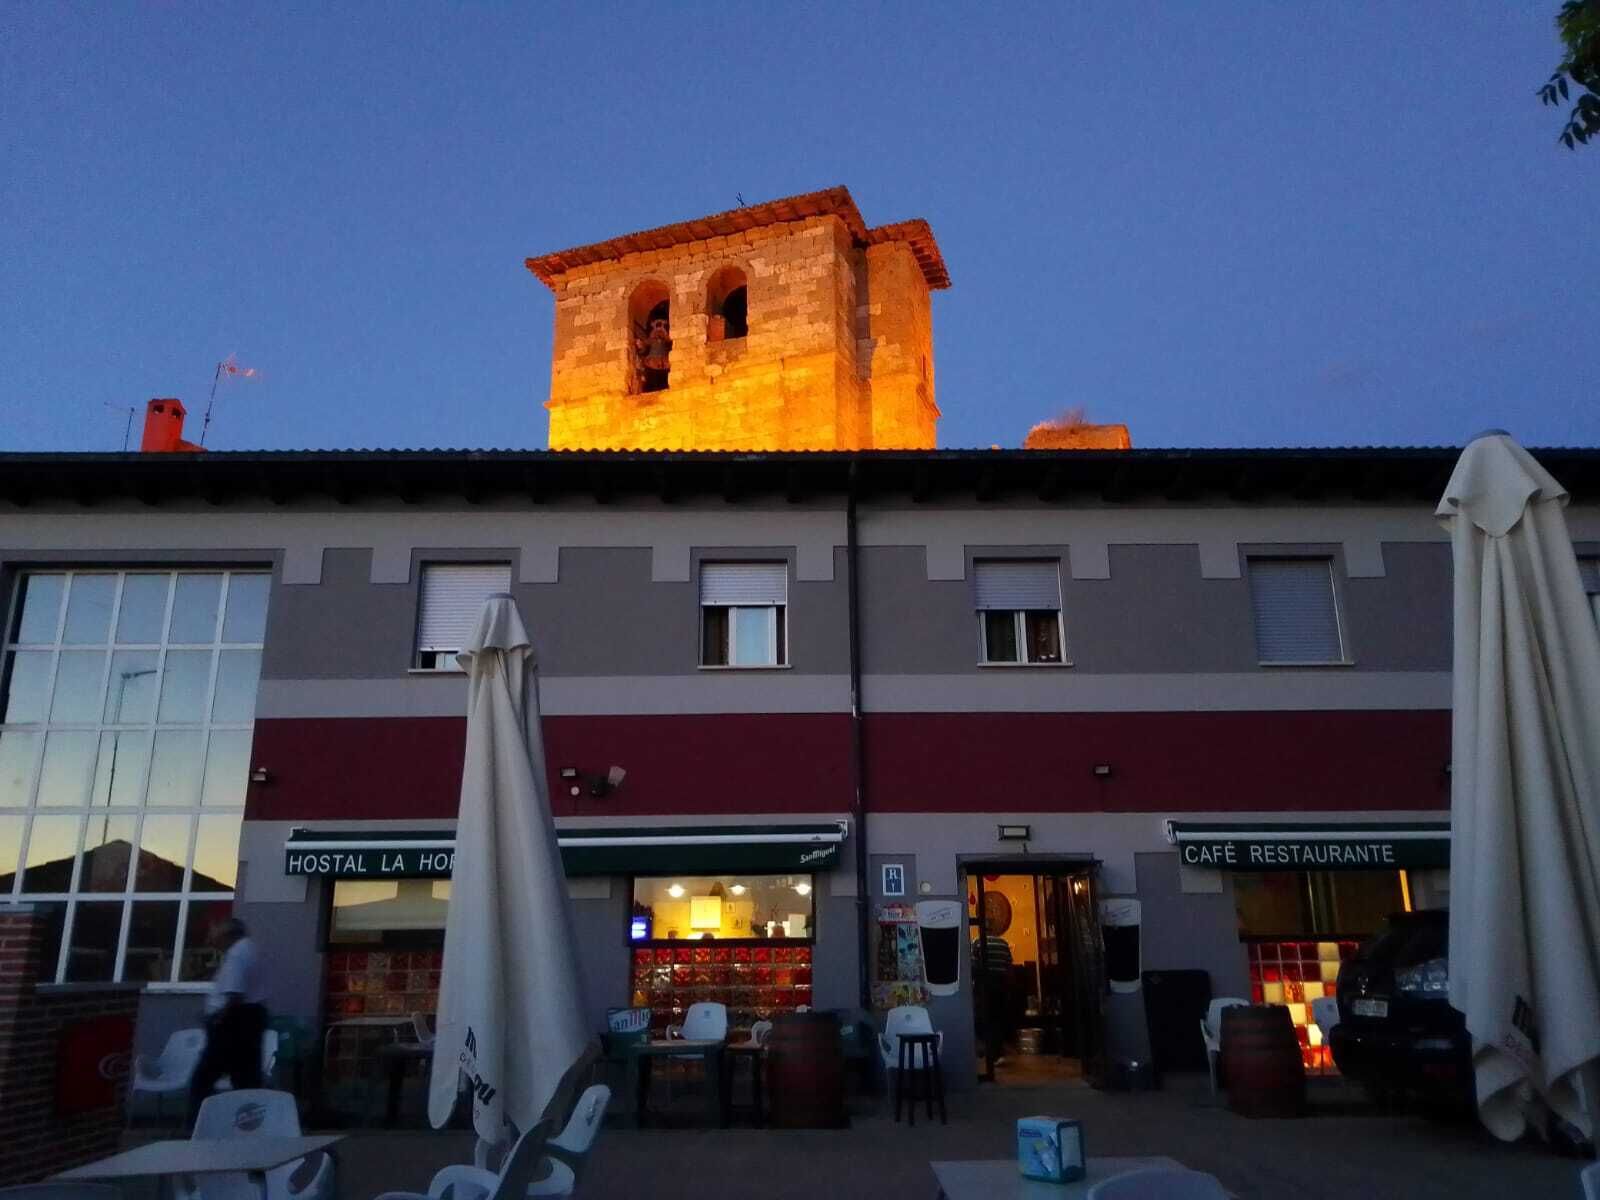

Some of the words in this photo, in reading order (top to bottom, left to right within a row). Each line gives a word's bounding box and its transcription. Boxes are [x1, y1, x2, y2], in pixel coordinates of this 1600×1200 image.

[288, 853, 367, 873] HOSTAL
[380, 853, 406, 873] LA
[1185, 841, 1238, 865] CAFÉ
[1249, 844, 1395, 864] RESTAURANTE
